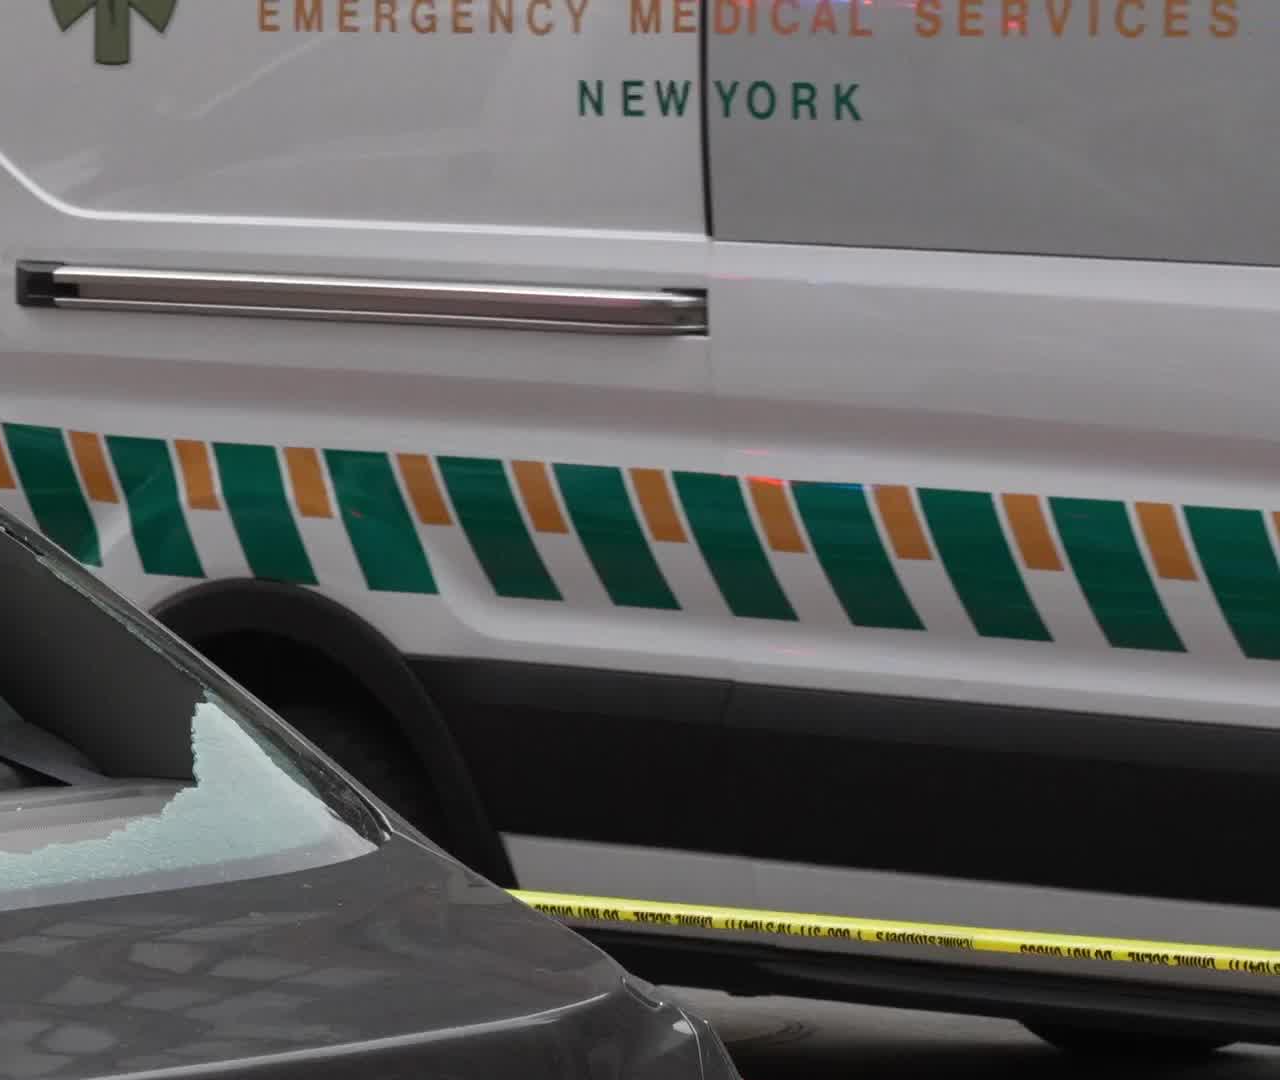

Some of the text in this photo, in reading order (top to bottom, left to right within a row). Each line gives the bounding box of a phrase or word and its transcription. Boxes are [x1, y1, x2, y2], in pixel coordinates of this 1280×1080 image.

[257, 0, 1240, 38] EMERGENCY MEDICAL SERVICES
[578, 79, 862, 122] NEW YORK
